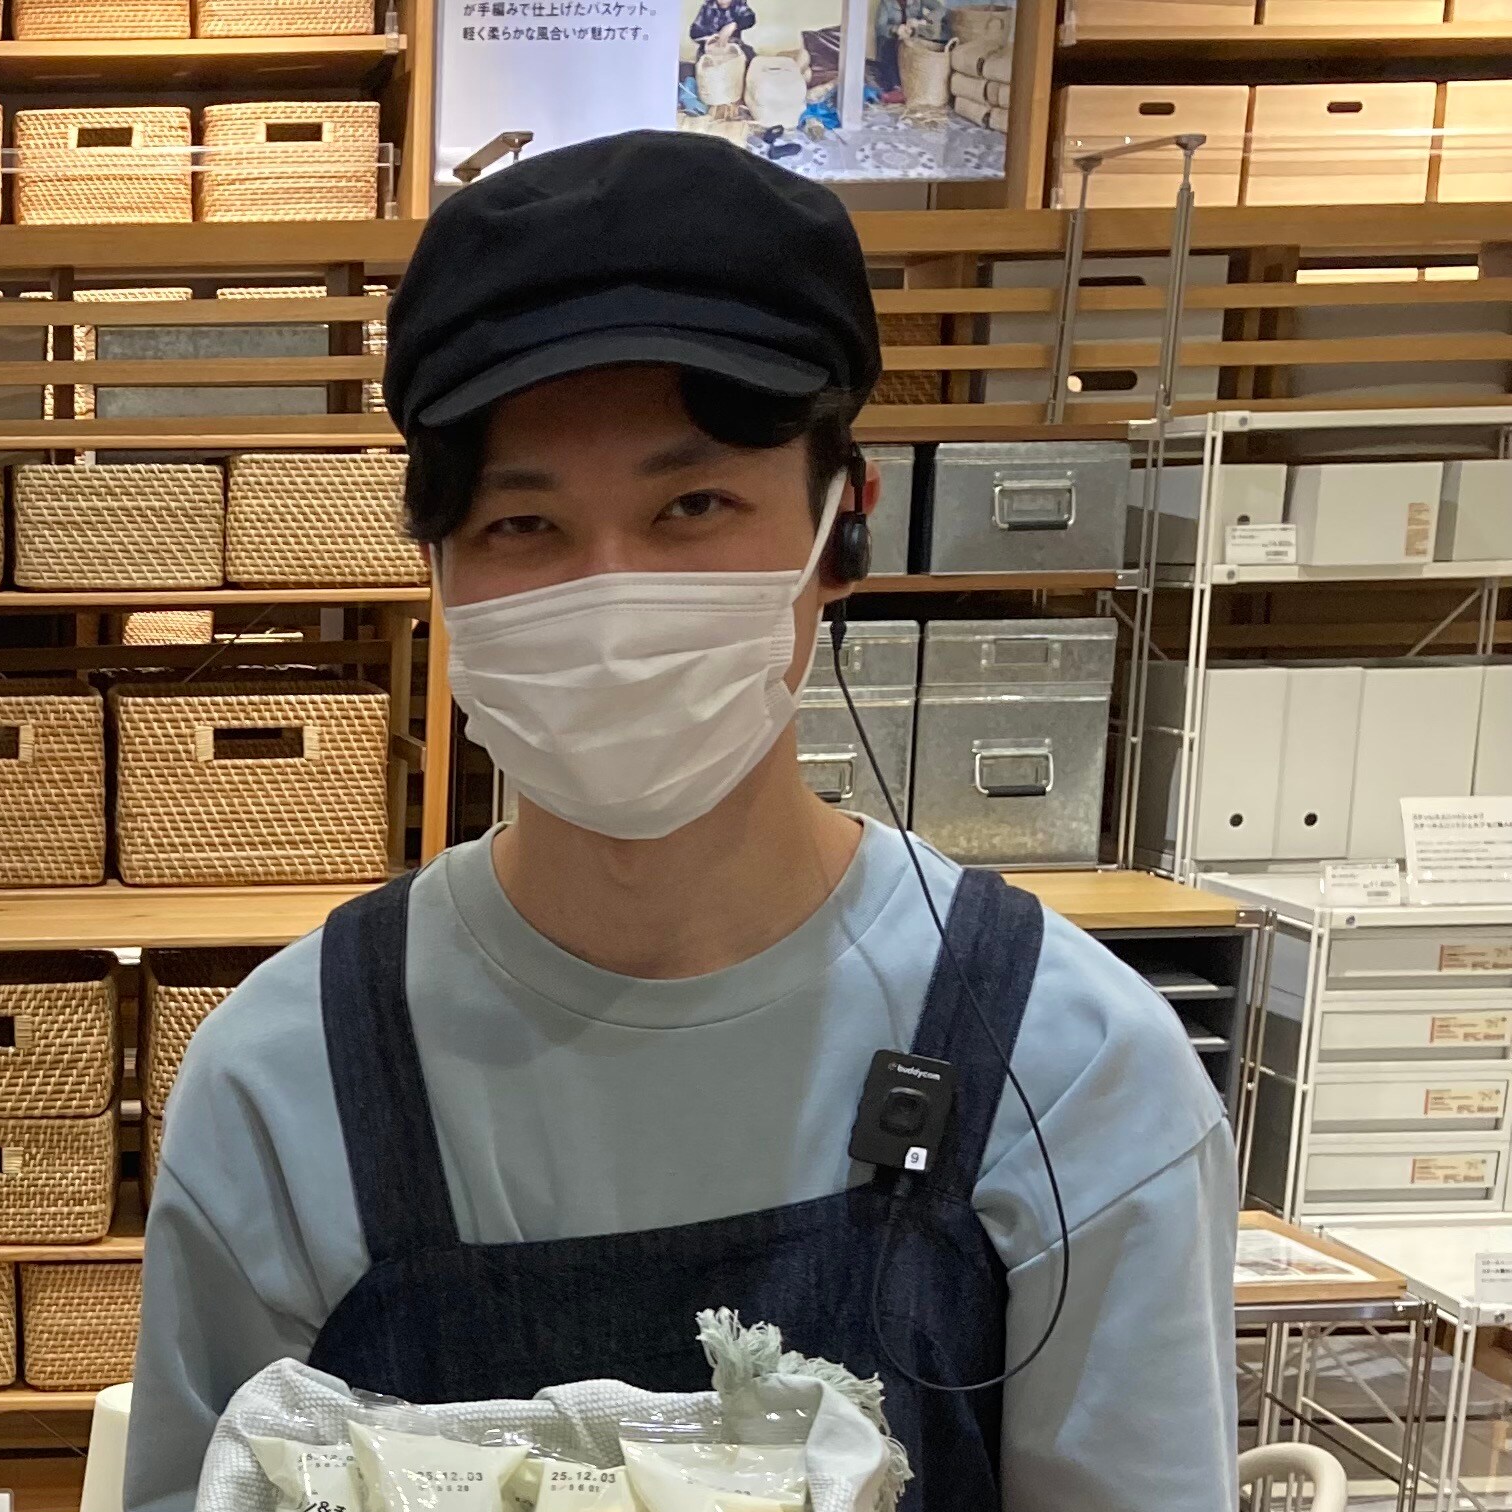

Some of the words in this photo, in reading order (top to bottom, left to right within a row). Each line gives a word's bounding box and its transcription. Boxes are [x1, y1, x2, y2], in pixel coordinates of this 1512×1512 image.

[463, 26, 649, 41] 軽く柔らかな風合いが魅力です。
[897, 1063, 941, 1081] buddycom
[551, 1471, 616, 1483] 25.12.03
